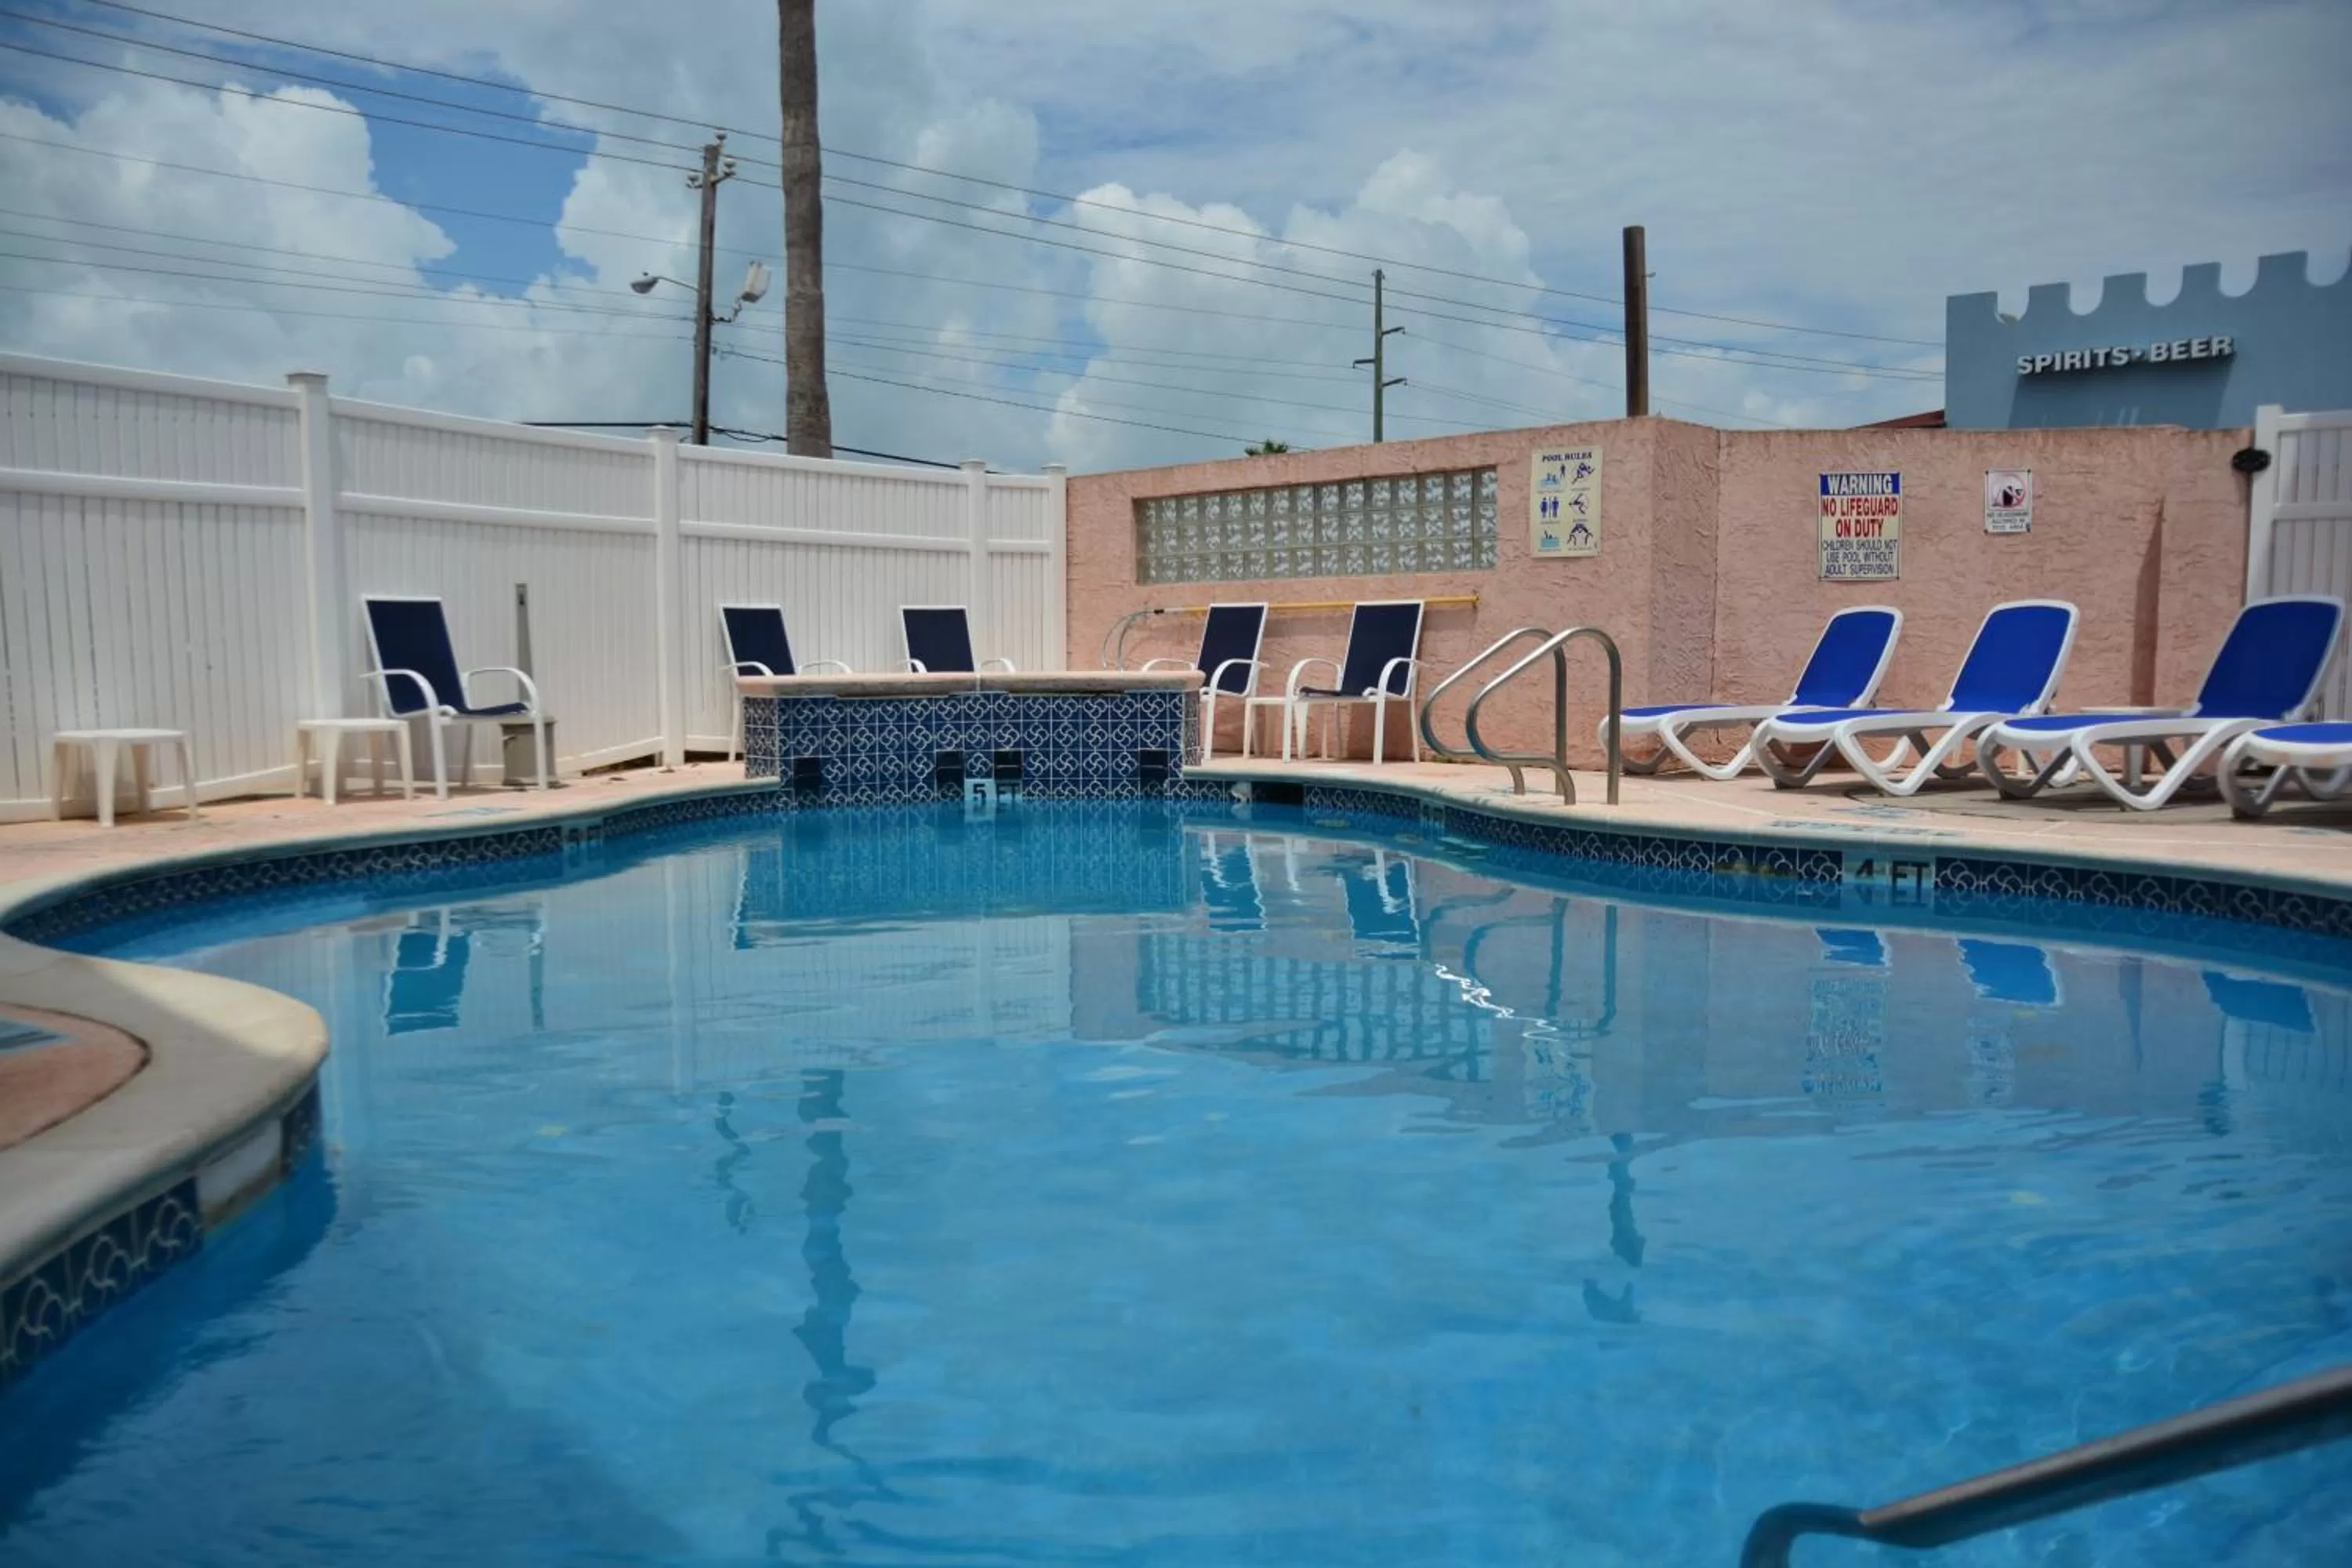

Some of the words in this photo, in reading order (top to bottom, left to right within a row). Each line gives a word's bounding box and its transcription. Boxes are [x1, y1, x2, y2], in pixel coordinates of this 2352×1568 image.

[2017, 346, 2129, 375] SPIRITS
[2150, 335, 2233, 363] BEER
[1542, 454, 1563, 463] POOL
[1565, 452, 1592, 461] RULES
[1828, 474, 1893, 495] WARNING
[1822, 497, 1837, 517] NO
[1840, 497, 1898, 517] LIFEGUARD
[1835, 518, 1851, 538] ON
[1854, 518, 1884, 538] DUTY
[1856, 539, 1882, 550] SHOULD
[1864, 551, 1893, 562] WITHOUT
[1825, 564, 1846, 575] ADULT
[973, 783, 986, 802] 5
[1855, 858, 1875, 880] 4
[1891, 859, 1930, 885] FT
